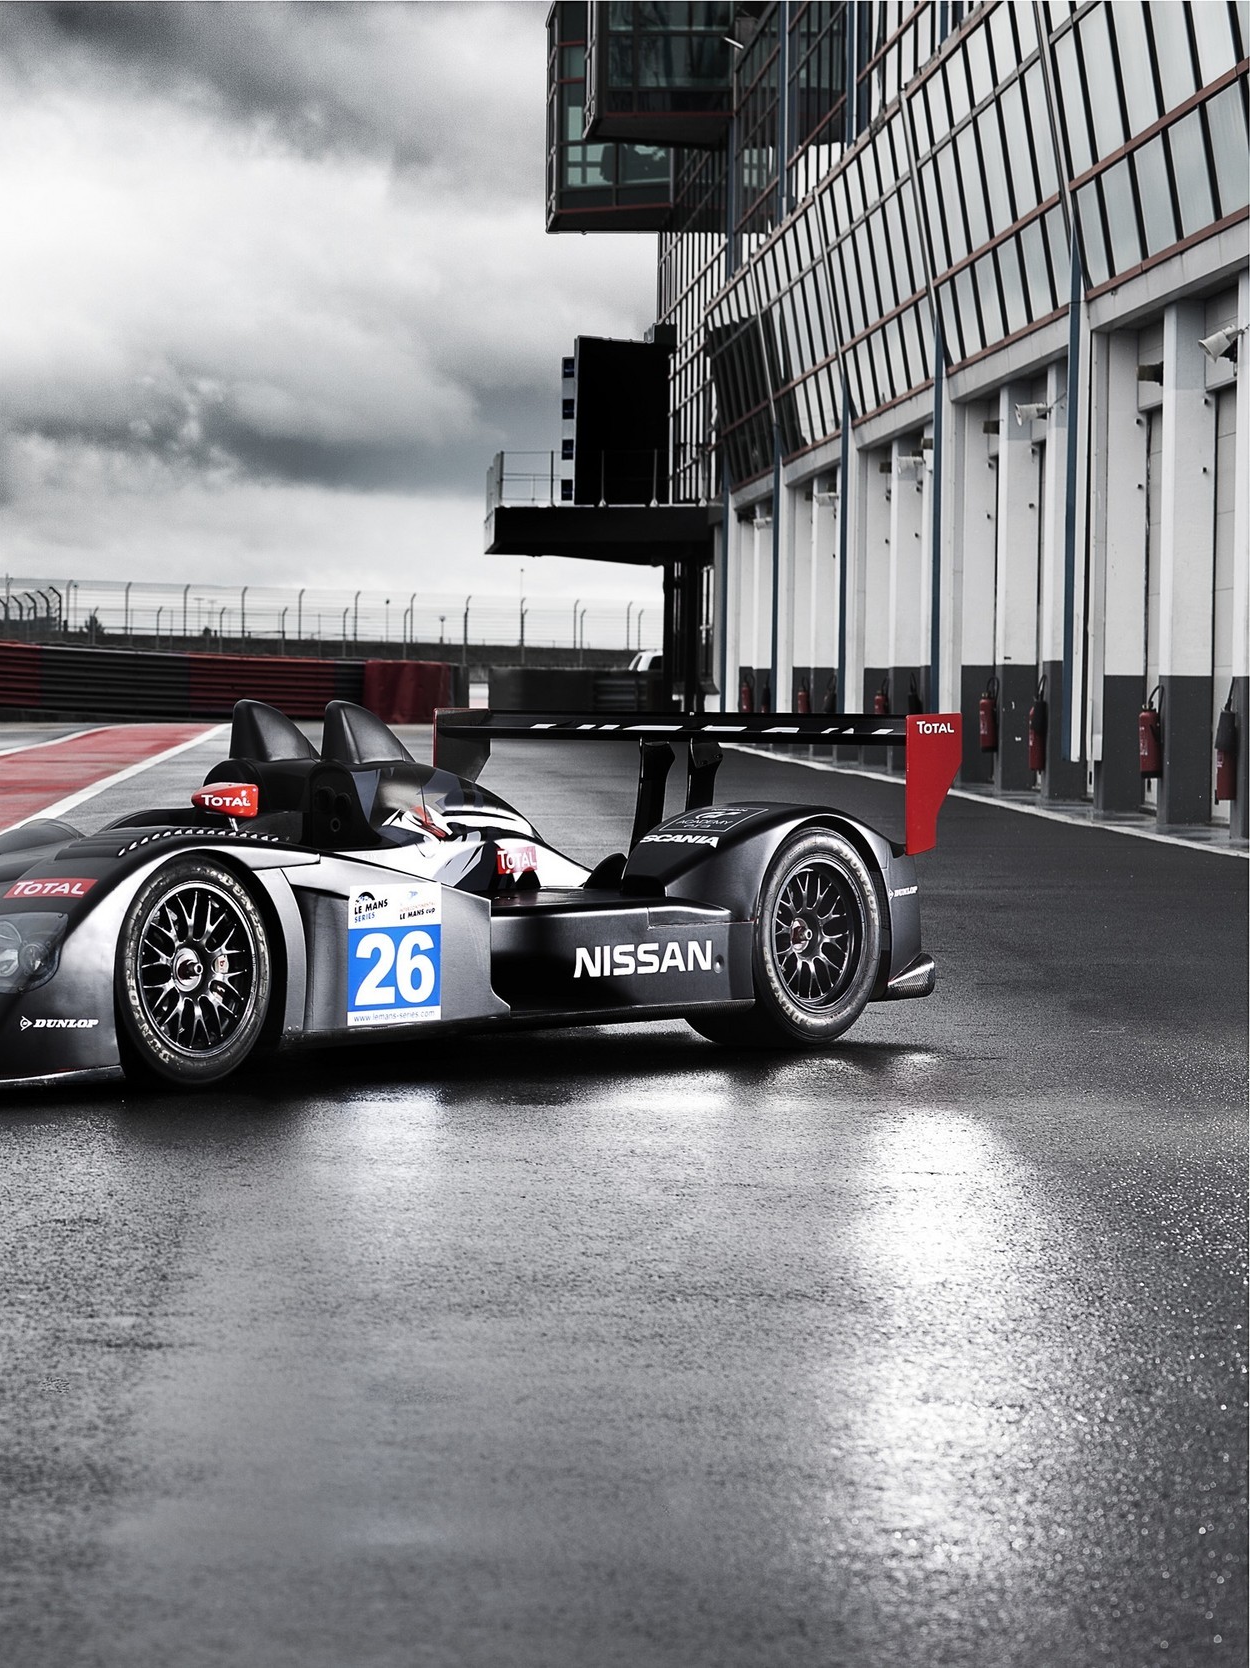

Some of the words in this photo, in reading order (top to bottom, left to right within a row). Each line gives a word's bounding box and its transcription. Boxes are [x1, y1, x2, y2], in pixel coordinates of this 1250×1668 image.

[639, 834, 720, 848] SCANIA
[354, 905, 362, 916] LE
[365, 898, 388, 913] MANS
[407, 908, 424, 919] MANS
[354, 911, 376, 923] SERIES
[573, 940, 712, 978] NISSAN
[354, 930, 435, 1006] 26
[353, 1010, 435, 1022] www.lemans-series.com
[32, 1018, 100, 1029] DUNLOP
